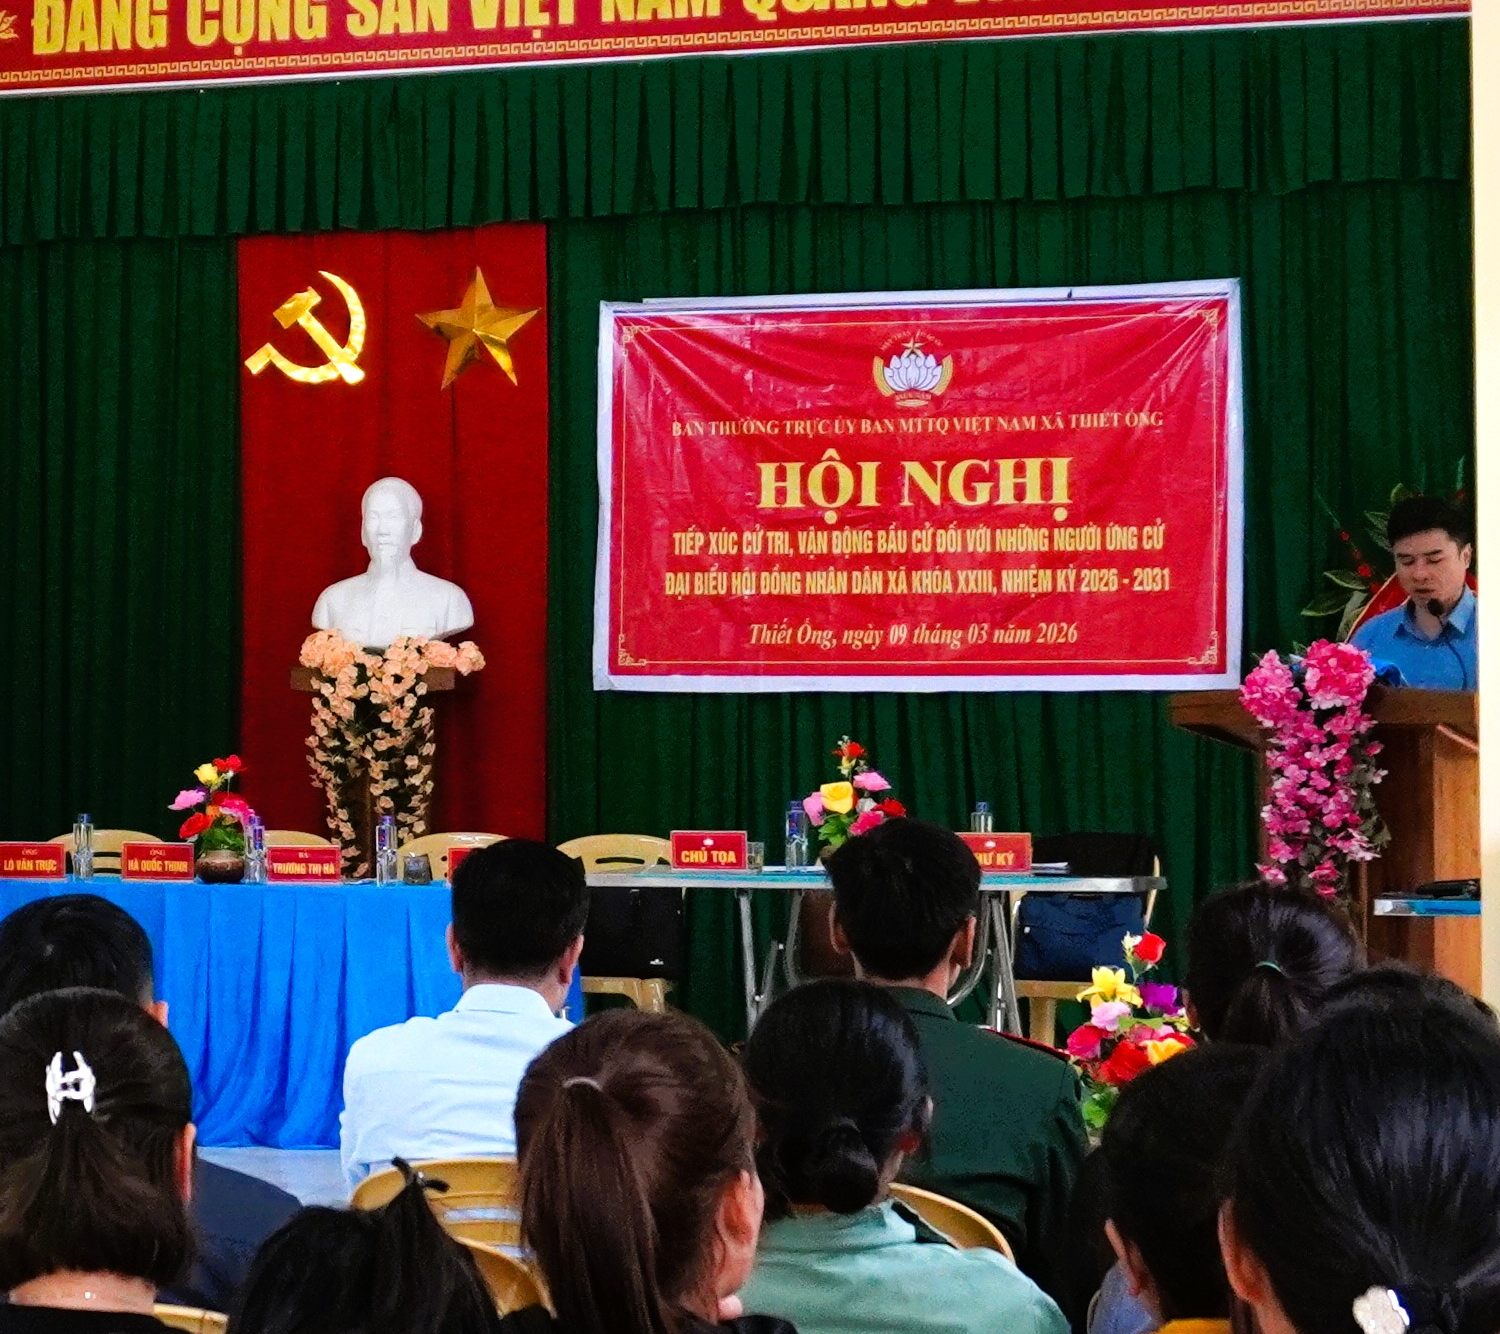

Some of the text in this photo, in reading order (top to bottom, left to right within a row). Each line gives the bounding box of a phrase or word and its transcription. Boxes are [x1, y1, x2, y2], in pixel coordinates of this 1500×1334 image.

[671, 421, 704, 437] BAN
[708, 417, 779, 435] THƯỜNG
[783, 418, 831, 439] TRỰC
[861, 418, 894, 434] BAN
[899, 417, 949, 435] MTTQ
[952, 414, 993, 435] VIỆT
[996, 415, 1037, 432] NAM
[1040, 411, 1065, 430] XÃ
[755, 447, 1074, 525] HỘI NGHỊ
[673, 525, 705, 556] TIẾP
[708, 527, 739, 555] XÚC
[742, 524, 764, 555] CỬ
[766, 530, 794, 558] TRI,
[798, 525, 828, 560] VẬN
[831, 525, 873, 560] ĐỘNG
[912, 521, 933, 554] CỬ
[935, 520, 962, 553] ĐỐI
[966, 524, 991, 553] VỚI
[995, 523, 1050, 553] NHỮNG
[1053, 521, 1101, 551] NGƯỜI
[1105, 522, 1138, 551] ỨNG
[1142, 517, 1166, 550] CỬ
[665, 571, 691, 601] ĐẠI
[694, 562, 728, 595] BIỂU
[731, 567, 756, 599] HỘI
[805, 565, 848, 595] NHÂN
[851, 565, 883, 595] DÂN
[887, 566, 908, 595] XÃ
[911, 565, 952, 594] KHÓA
[957, 569, 998, 596] XXIII,
[1001, 563, 1053, 598] NHIỆM
[1056, 563, 1077, 593] KỲ
[1080, 568, 1119, 593] 2026
[1132, 567, 1170, 592] 2031
[749, 618, 792, 646] Thiết
[842, 623, 884, 650] ngày
[889, 623, 908, 644] 09
[912, 623, 963, 649] tháng
[967, 623, 988, 644] 03
[992, 623, 1031, 644] năm
[1035, 621, 1079, 644] 2026
[681, 846, 737, 866] CHỦ TỌA
[996, 850, 1015, 866] KÝ
